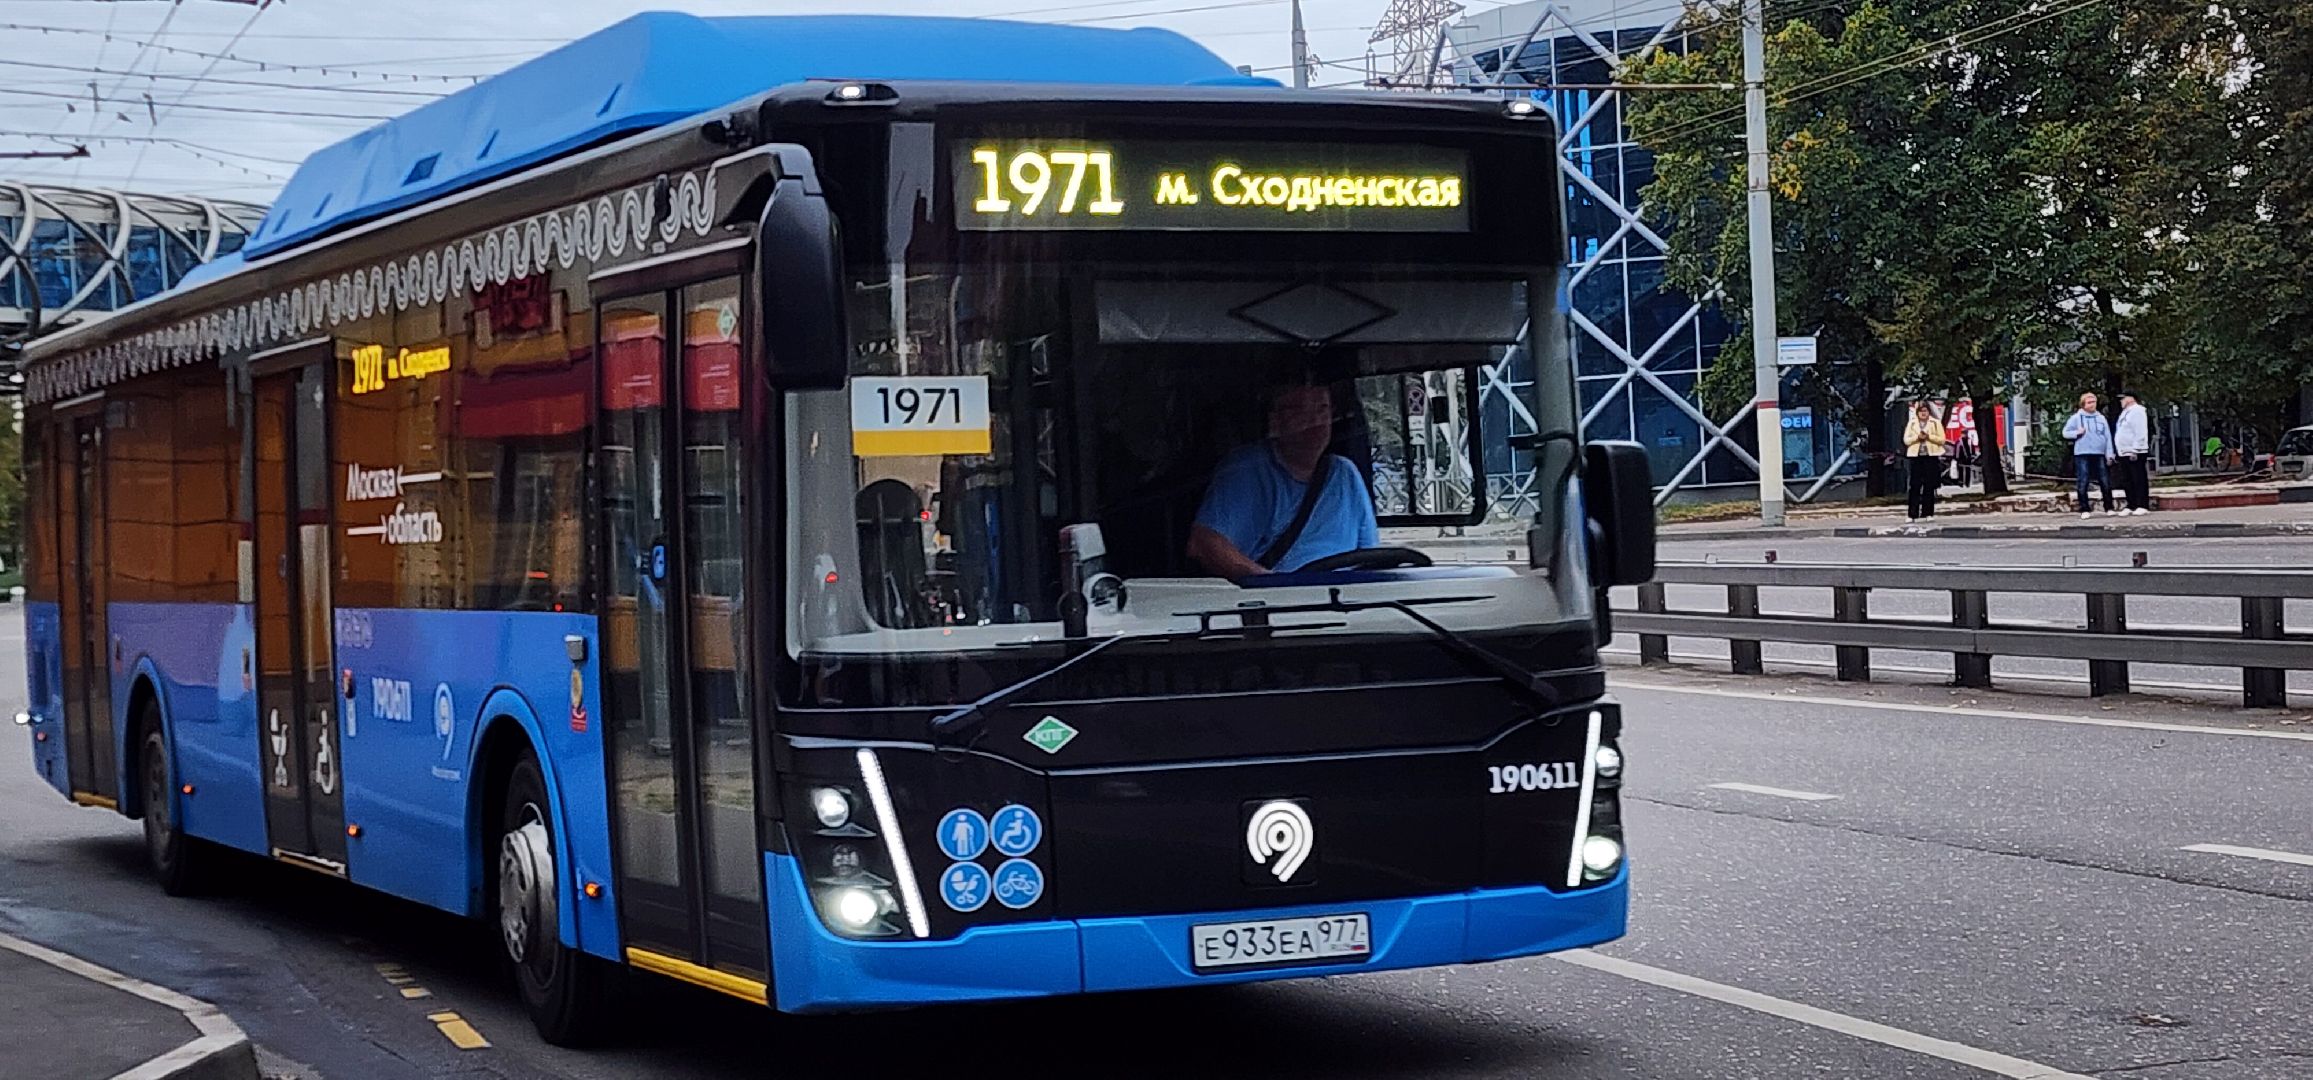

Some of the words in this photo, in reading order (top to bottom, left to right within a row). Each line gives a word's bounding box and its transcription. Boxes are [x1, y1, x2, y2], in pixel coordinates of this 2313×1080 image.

[972, 149, 1125, 215] 1971
[1155, 173, 1199, 205] м.
[1211, 164, 1463, 213] Сходненская
[351, 344, 386, 394] 1971
[876, 386, 962, 425] 1971
[346, 463, 396, 501] Москва
[388, 503, 442, 544] область
[1034, 728, 1066, 742] КПГ
[1487, 761, 1580, 794] 190611
[1317, 917, 1359, 944] 977
